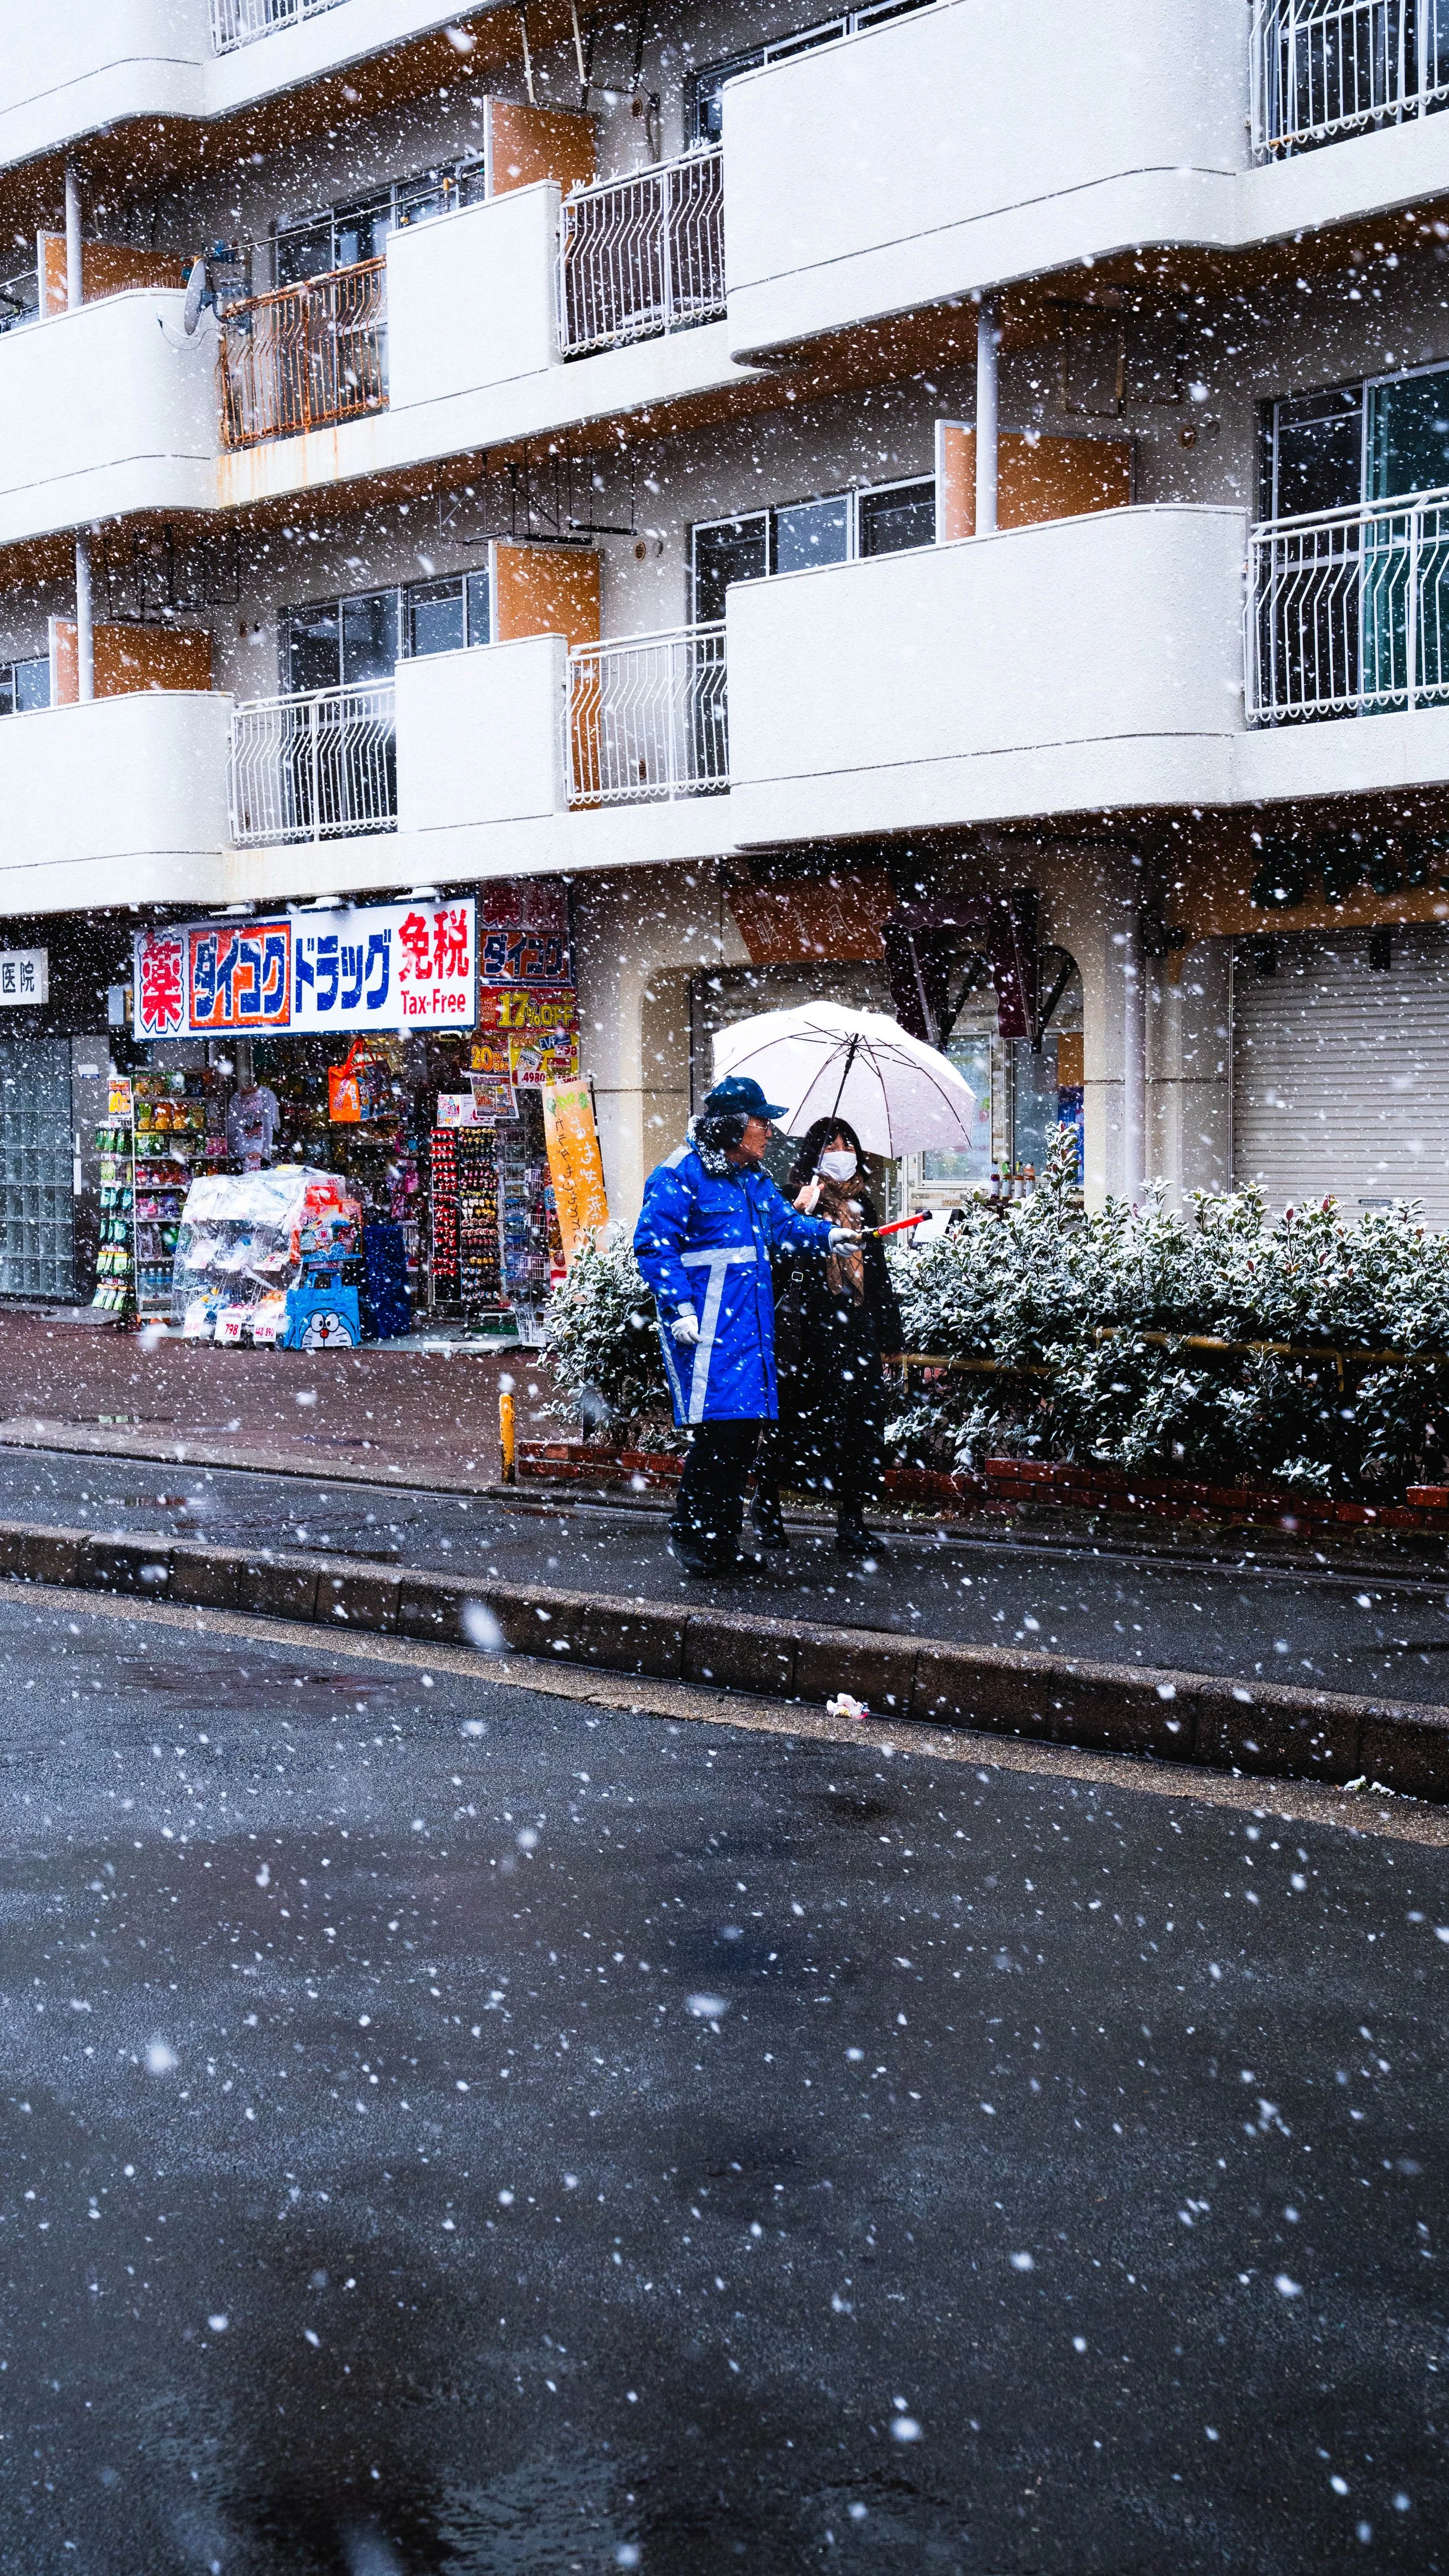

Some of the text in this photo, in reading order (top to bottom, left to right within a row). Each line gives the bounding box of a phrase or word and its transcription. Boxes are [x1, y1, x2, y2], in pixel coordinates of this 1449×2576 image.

[398, 909, 469, 982] 免税
[484, 934, 563, 975] ダイコク
[2, 961, 35, 993] 医院
[141, 930, 182, 1029] 薬
[401, 989, 466, 1015] Tax-Free
[224, 1324, 238, 1335] 798
